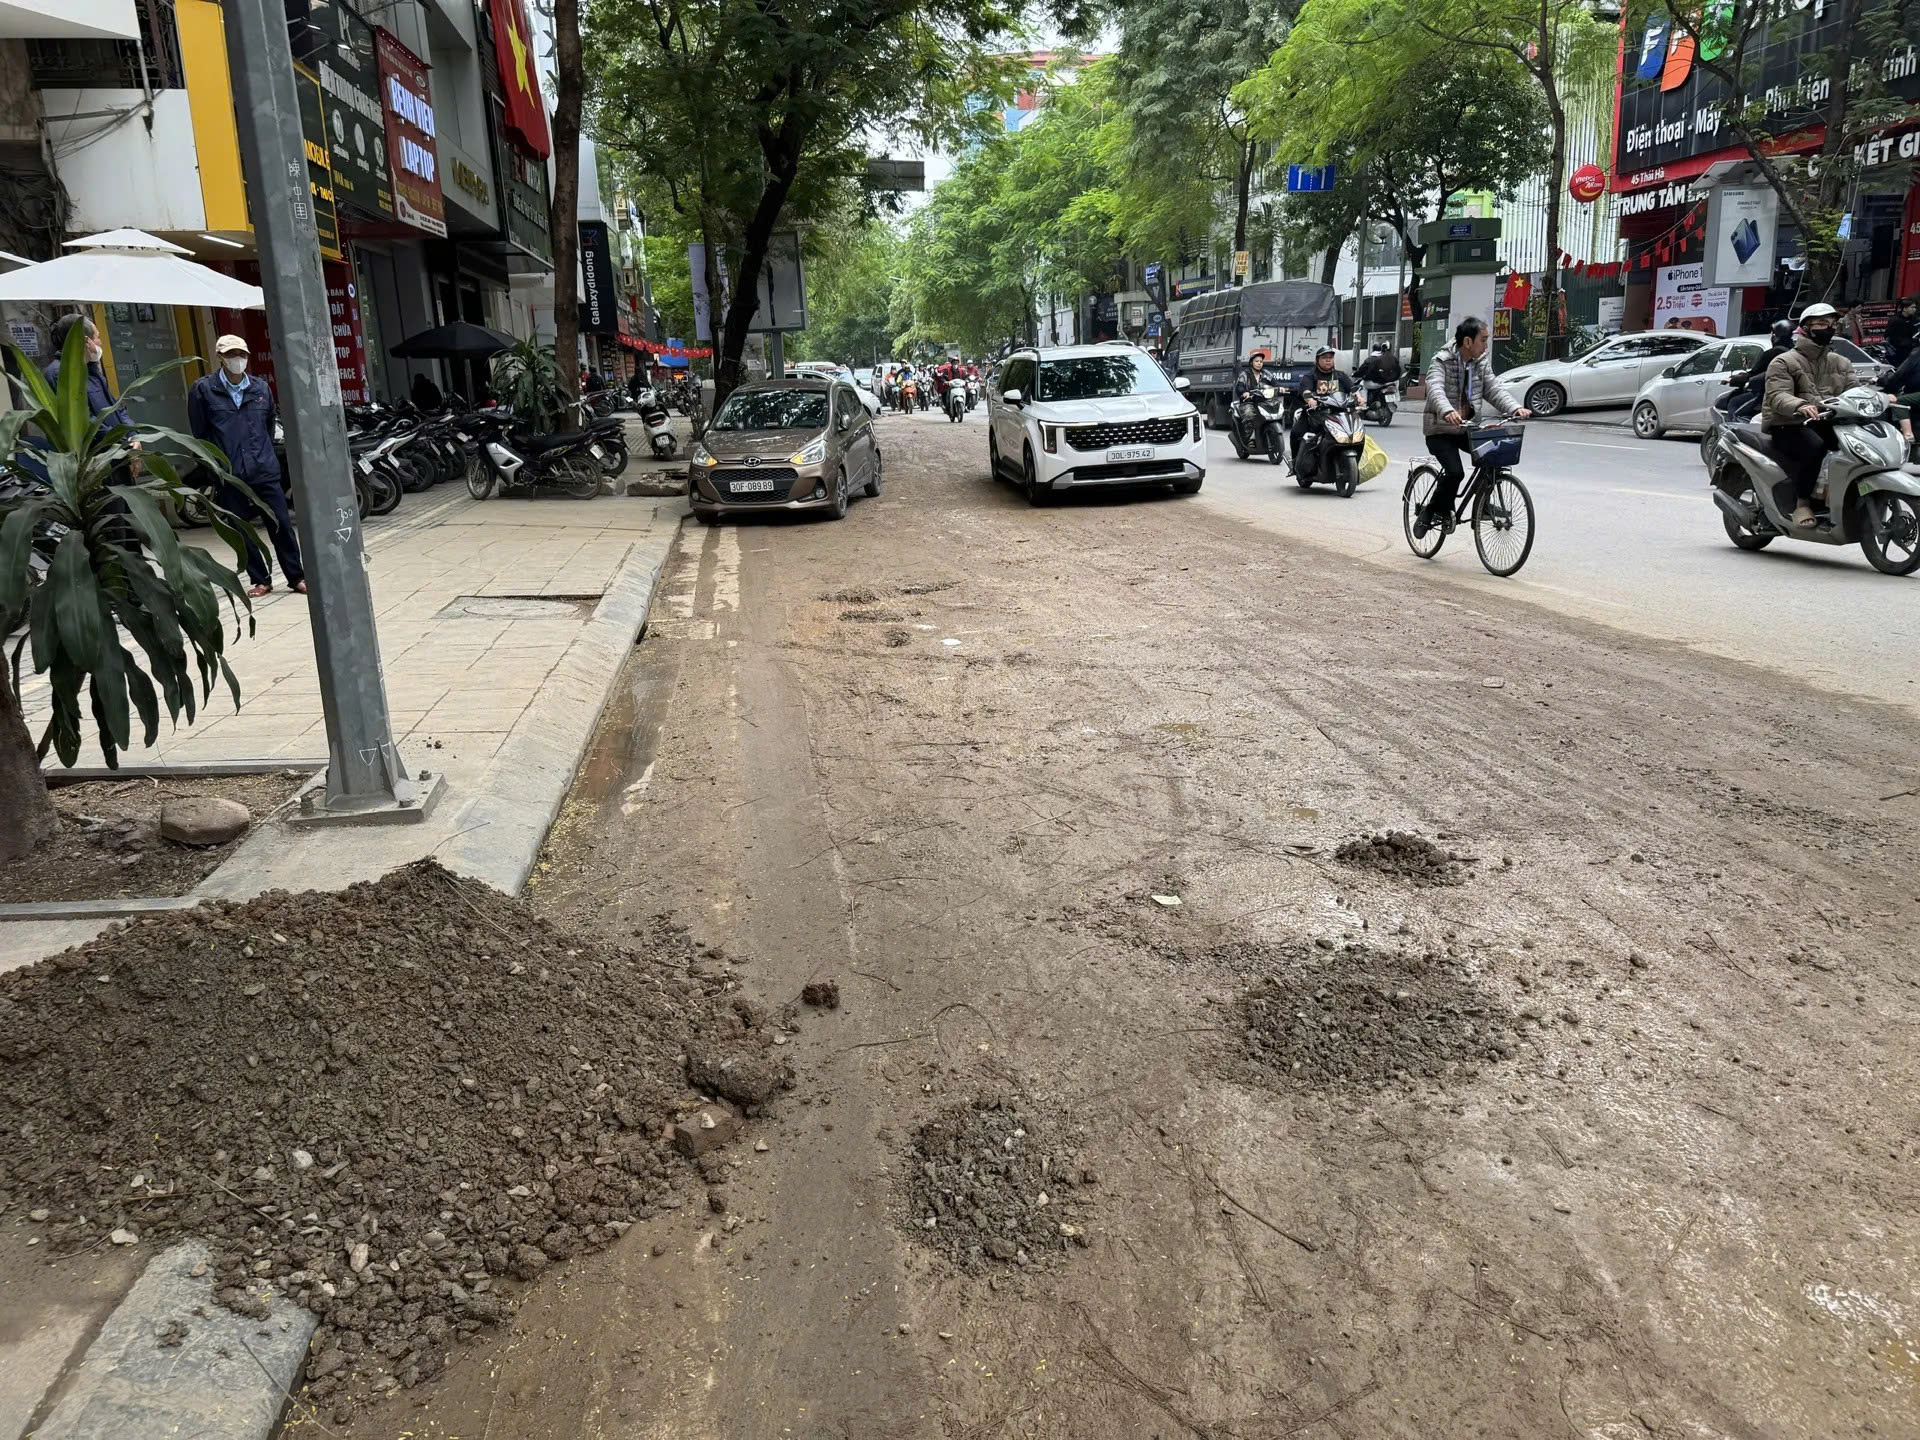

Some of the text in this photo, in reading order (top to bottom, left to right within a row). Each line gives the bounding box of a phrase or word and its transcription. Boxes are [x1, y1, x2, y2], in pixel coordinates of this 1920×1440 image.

[1626, 122, 1651, 156] Điện
[1655, 111, 1687, 148] thoại
[1695, 104, 1721, 136] Máy
[399, 136, 435, 183] LAPTOP
[1854, 130, 1894, 166] KẾT
[1631, 167, 1665, 184] 45 Thái Hà
[1615, 191, 1655, 217] TRUNG
[1659, 182, 1686, 209] TÂM
[1673, 268, 1699, 281] iPhone
[585, 250, 600, 326] Galaxydidong
[332, 303, 345, 318] ĐẶT
[1657, 296, 1672, 310] 2.5
[1672, 300, 1686, 311] Triệu
